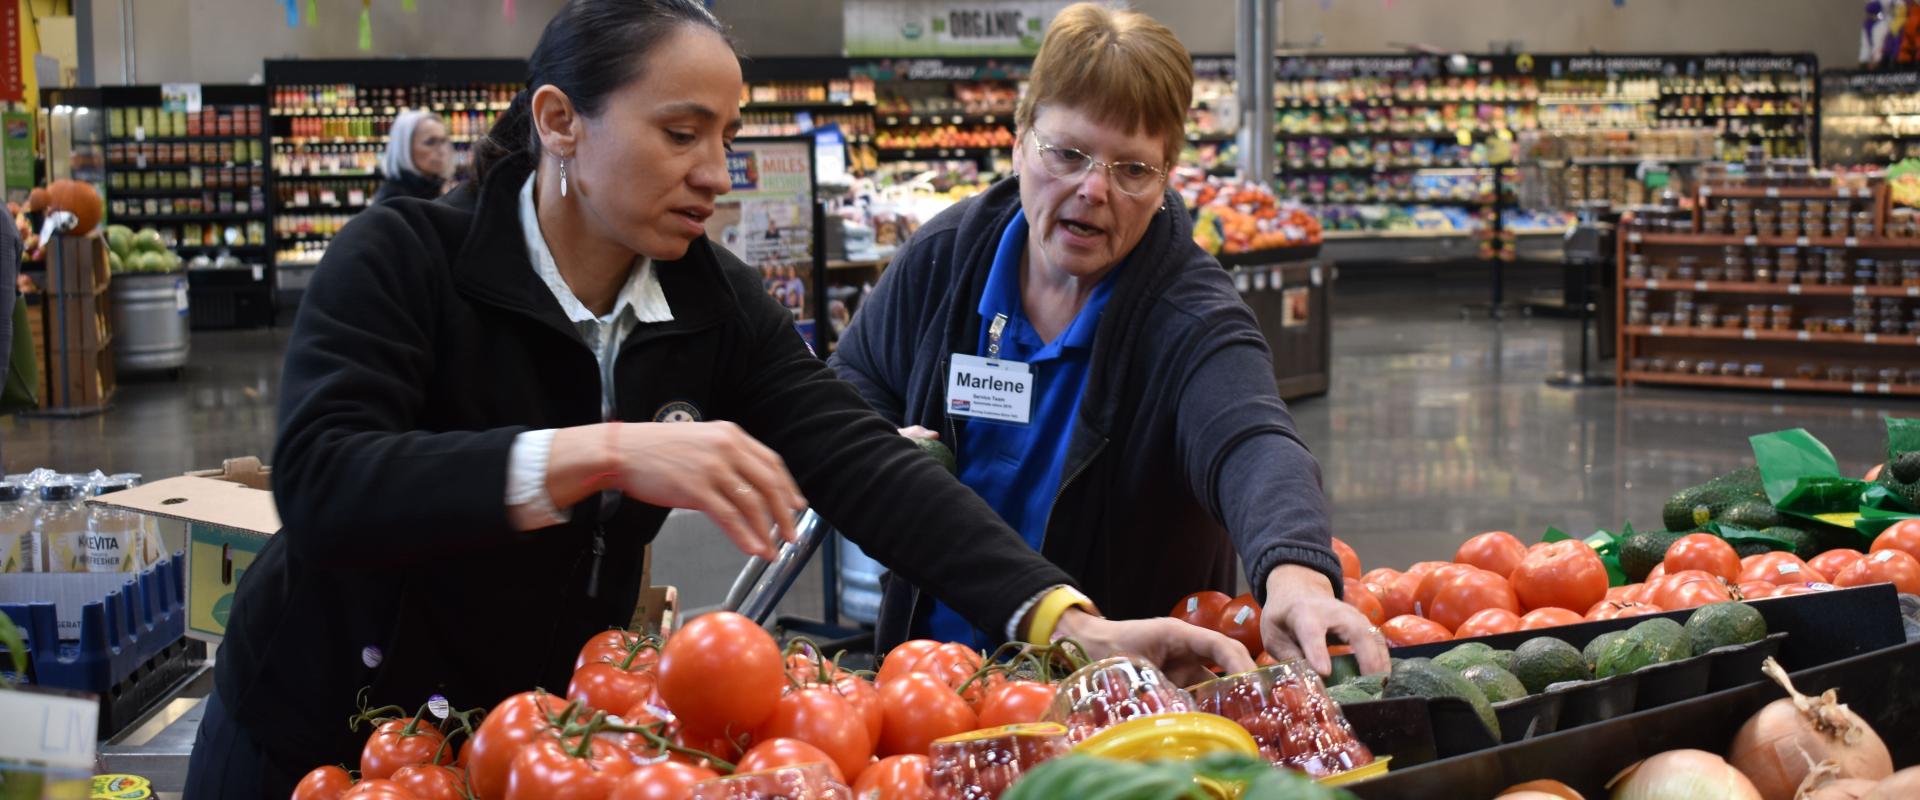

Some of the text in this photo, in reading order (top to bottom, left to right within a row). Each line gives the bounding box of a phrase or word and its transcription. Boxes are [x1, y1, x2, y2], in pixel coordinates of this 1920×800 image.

[951, 11, 1023, 37] ORGANIC
[764, 159, 805, 172] MILES
[957, 371, 1024, 393] Marlene
